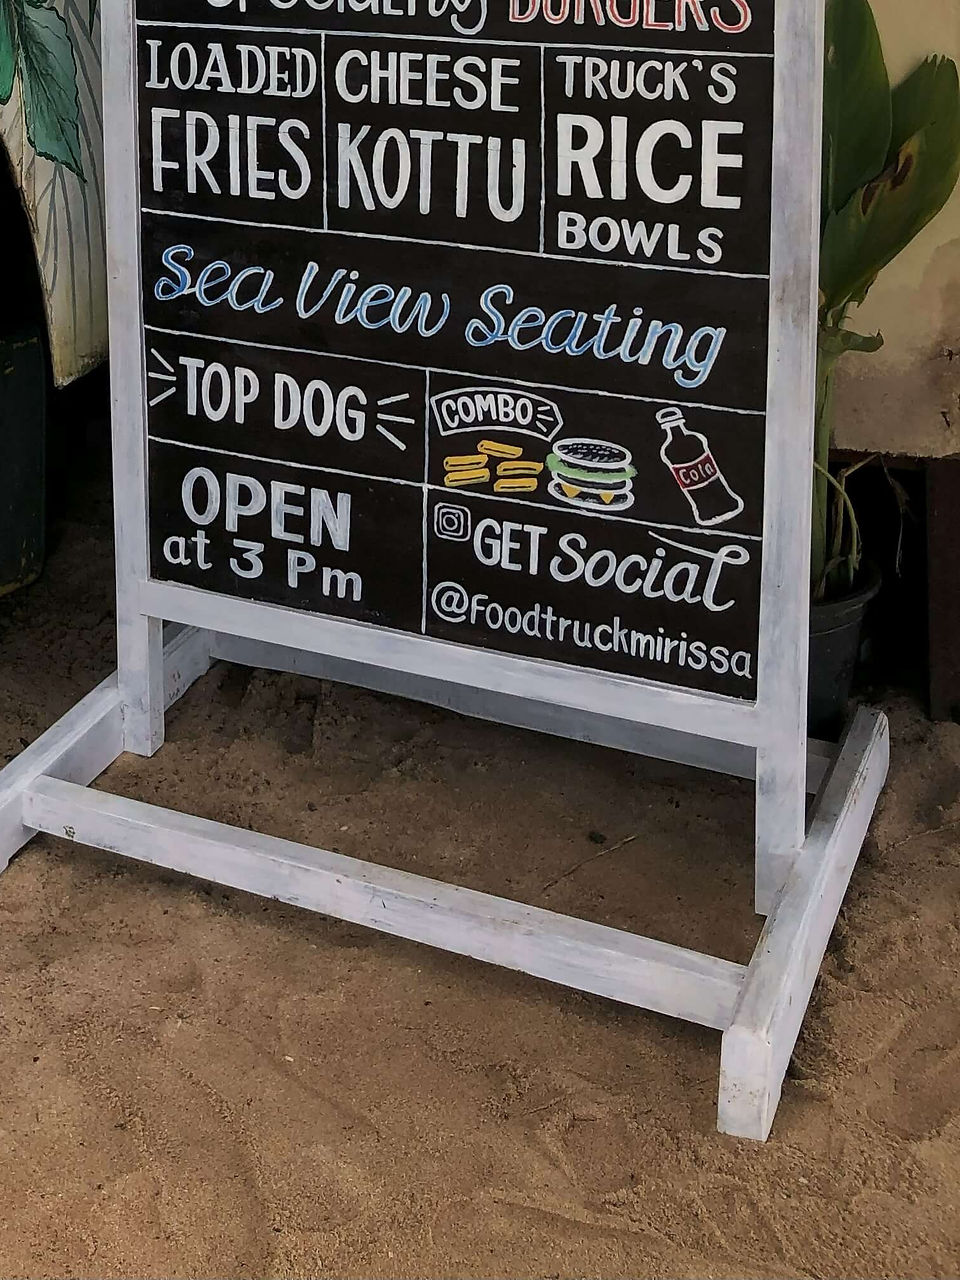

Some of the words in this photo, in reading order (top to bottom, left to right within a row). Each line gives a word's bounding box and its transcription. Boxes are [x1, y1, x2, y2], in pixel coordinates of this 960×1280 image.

[145, 39, 318, 98] LOADED
[335, 49, 521, 113] CHEESE
[555, 54, 738, 105] TRUCK'S
[151, 106, 312, 201] FRIES
[338, 122, 526, 223] KOTTU
[557, 113, 744, 210] RICE
[558, 211, 724, 264] BOWLS
[154, 244, 284, 314] Sea
[296, 260, 451, 338] View
[465, 284, 727, 389] Seating
[178, 355, 260, 424] TOP
[274, 372, 368, 442] DOG
[440, 392, 534, 428] COMBO
[181, 466, 352, 553] OPEN
[163, 529, 213, 571] at
[229, 538, 265, 580] 3
[473, 517, 548, 576] GET
[549, 530, 751, 613] Social
